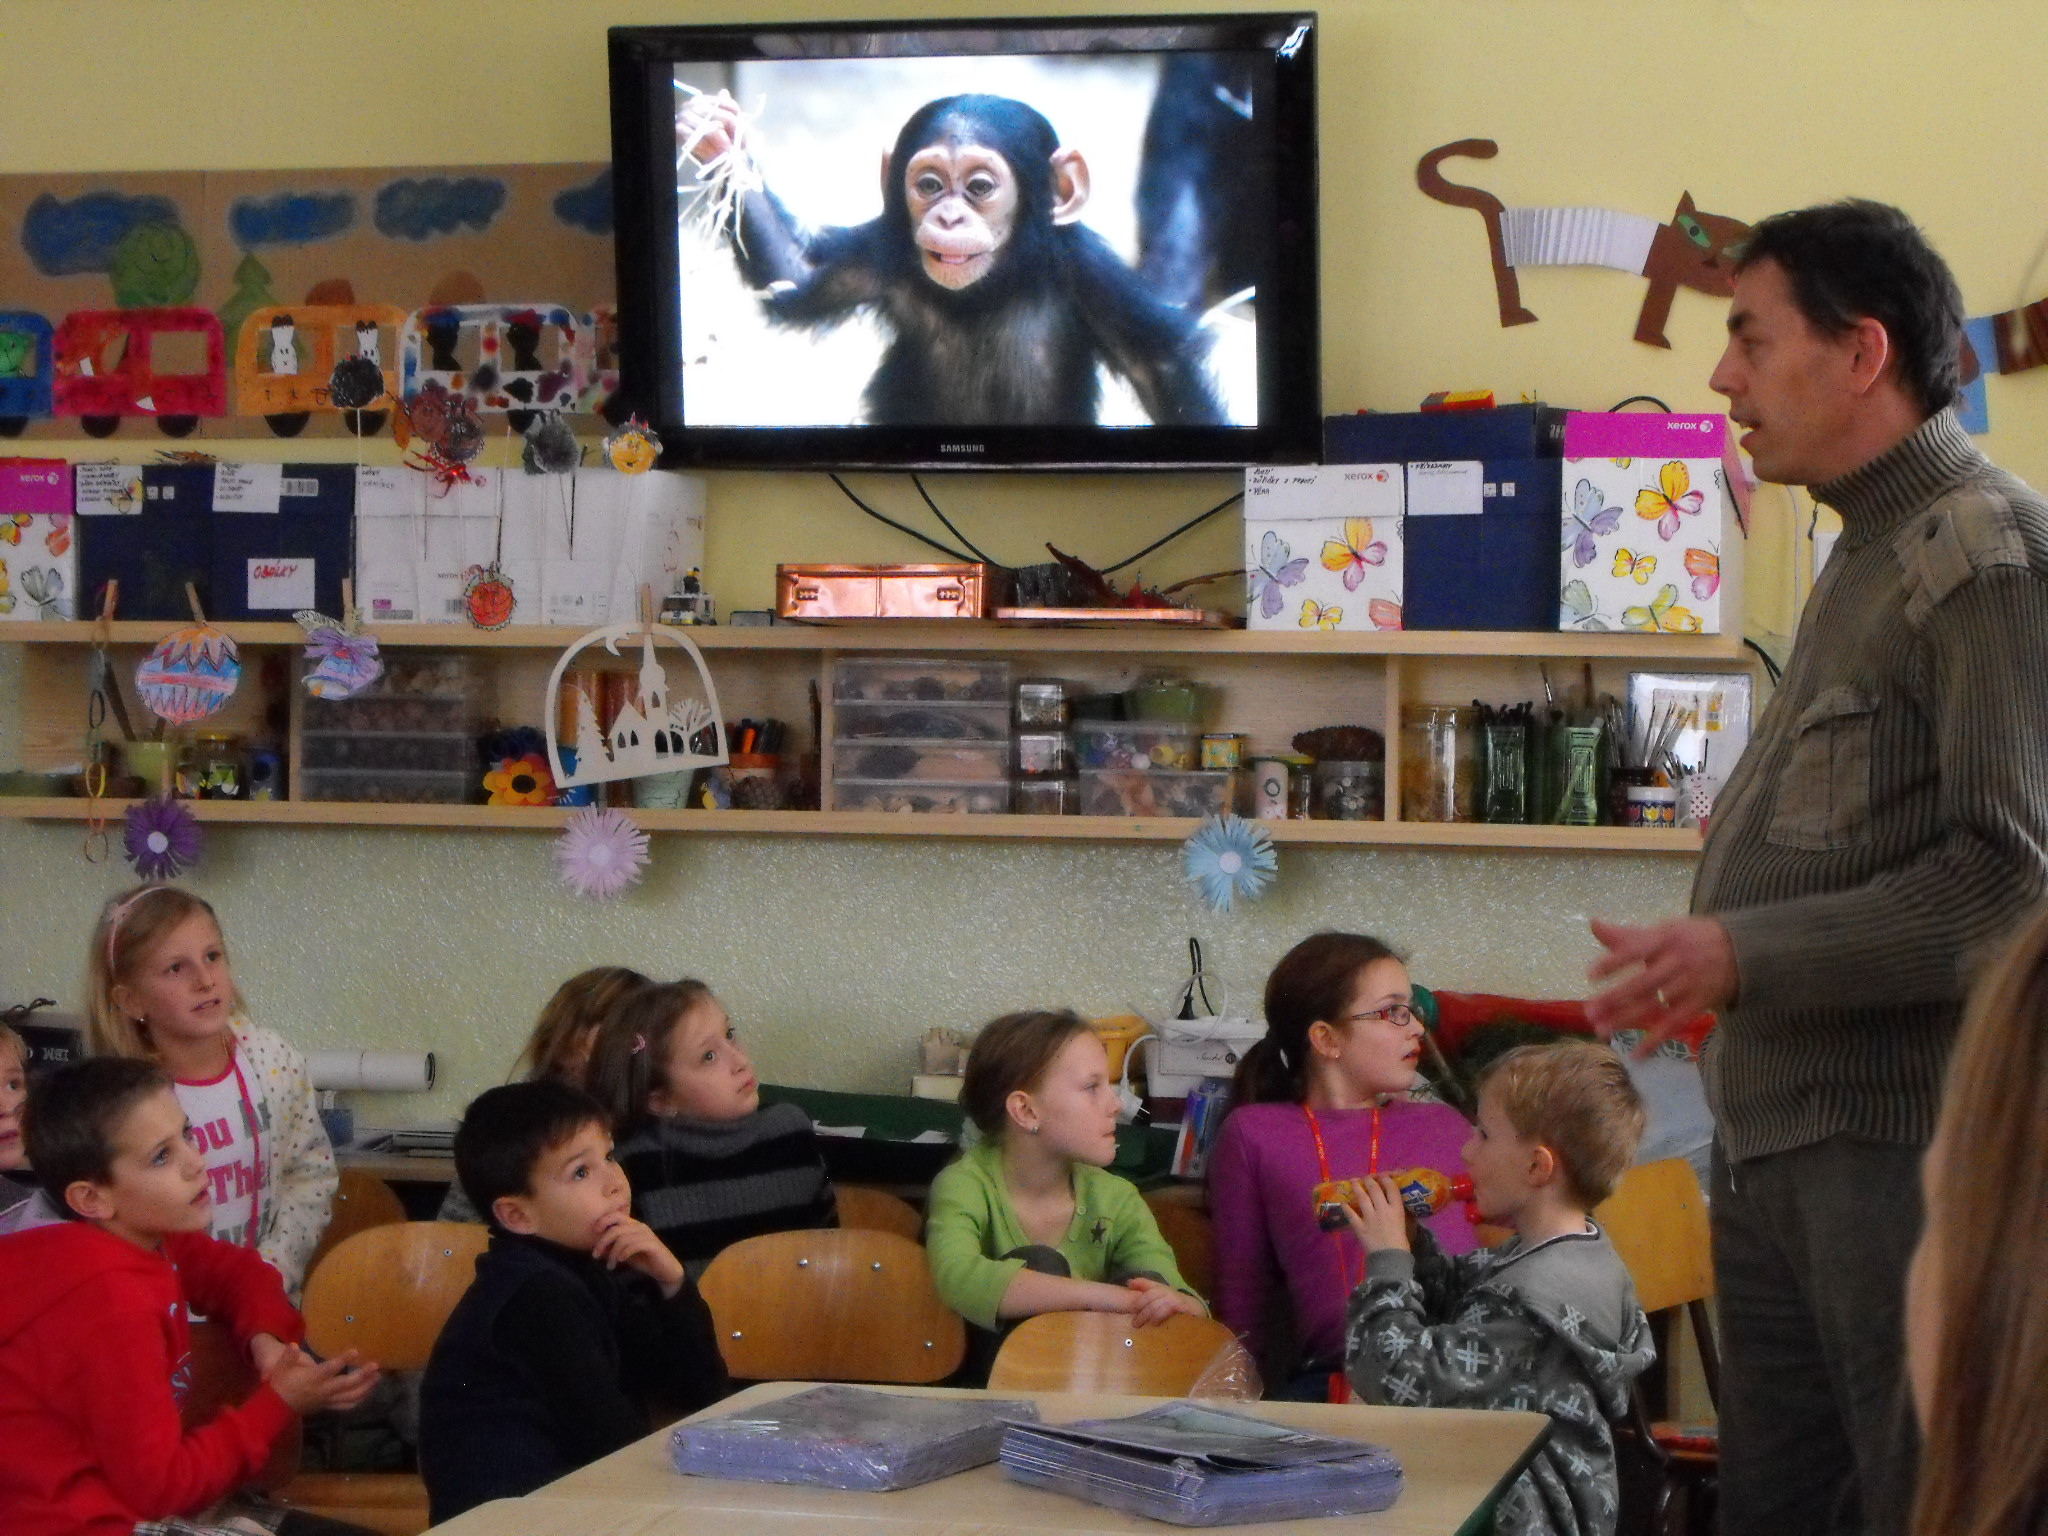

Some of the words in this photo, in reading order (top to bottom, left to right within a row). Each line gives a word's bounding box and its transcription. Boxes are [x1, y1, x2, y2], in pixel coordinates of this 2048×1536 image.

[1667, 420, 1697, 430] xerox
[940, 444, 985, 453] SAMSUNG
[1344, 472, 1374, 481] xerox
